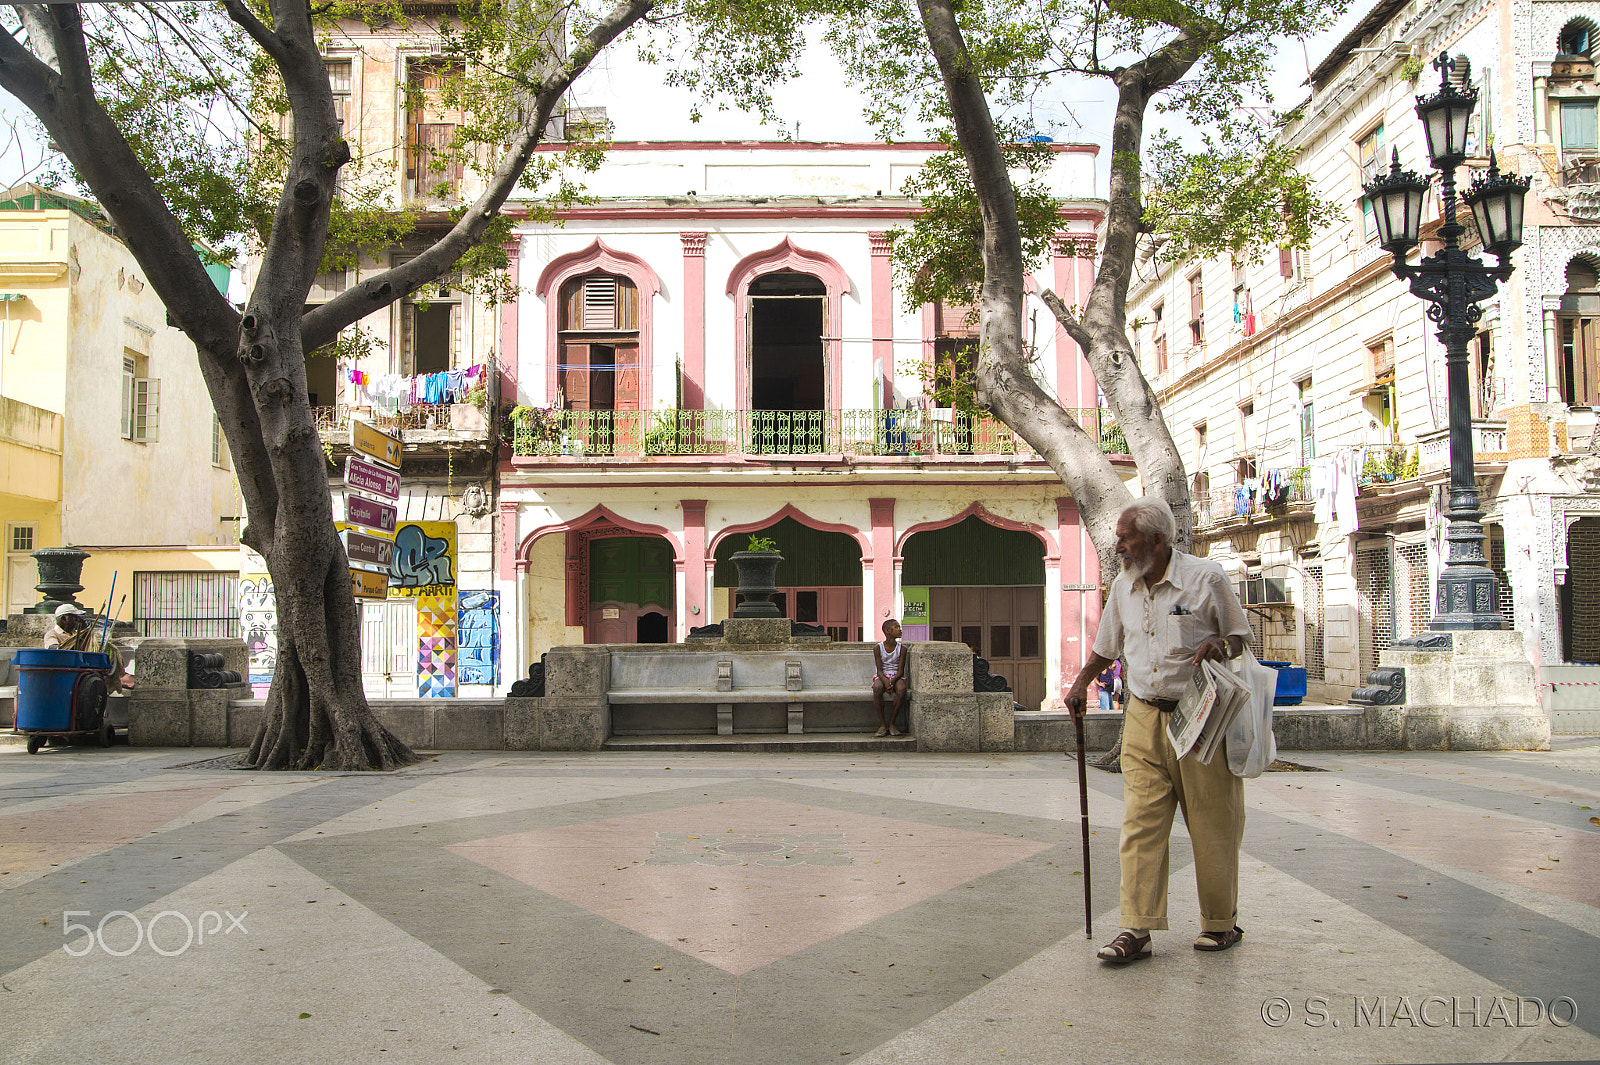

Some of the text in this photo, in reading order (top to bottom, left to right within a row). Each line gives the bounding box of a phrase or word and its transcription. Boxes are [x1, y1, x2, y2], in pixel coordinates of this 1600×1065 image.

[349, 472, 382, 491] Alicia Alonso
[350, 505, 371, 520] Capitolio
[360, 542, 376, 554] Central
